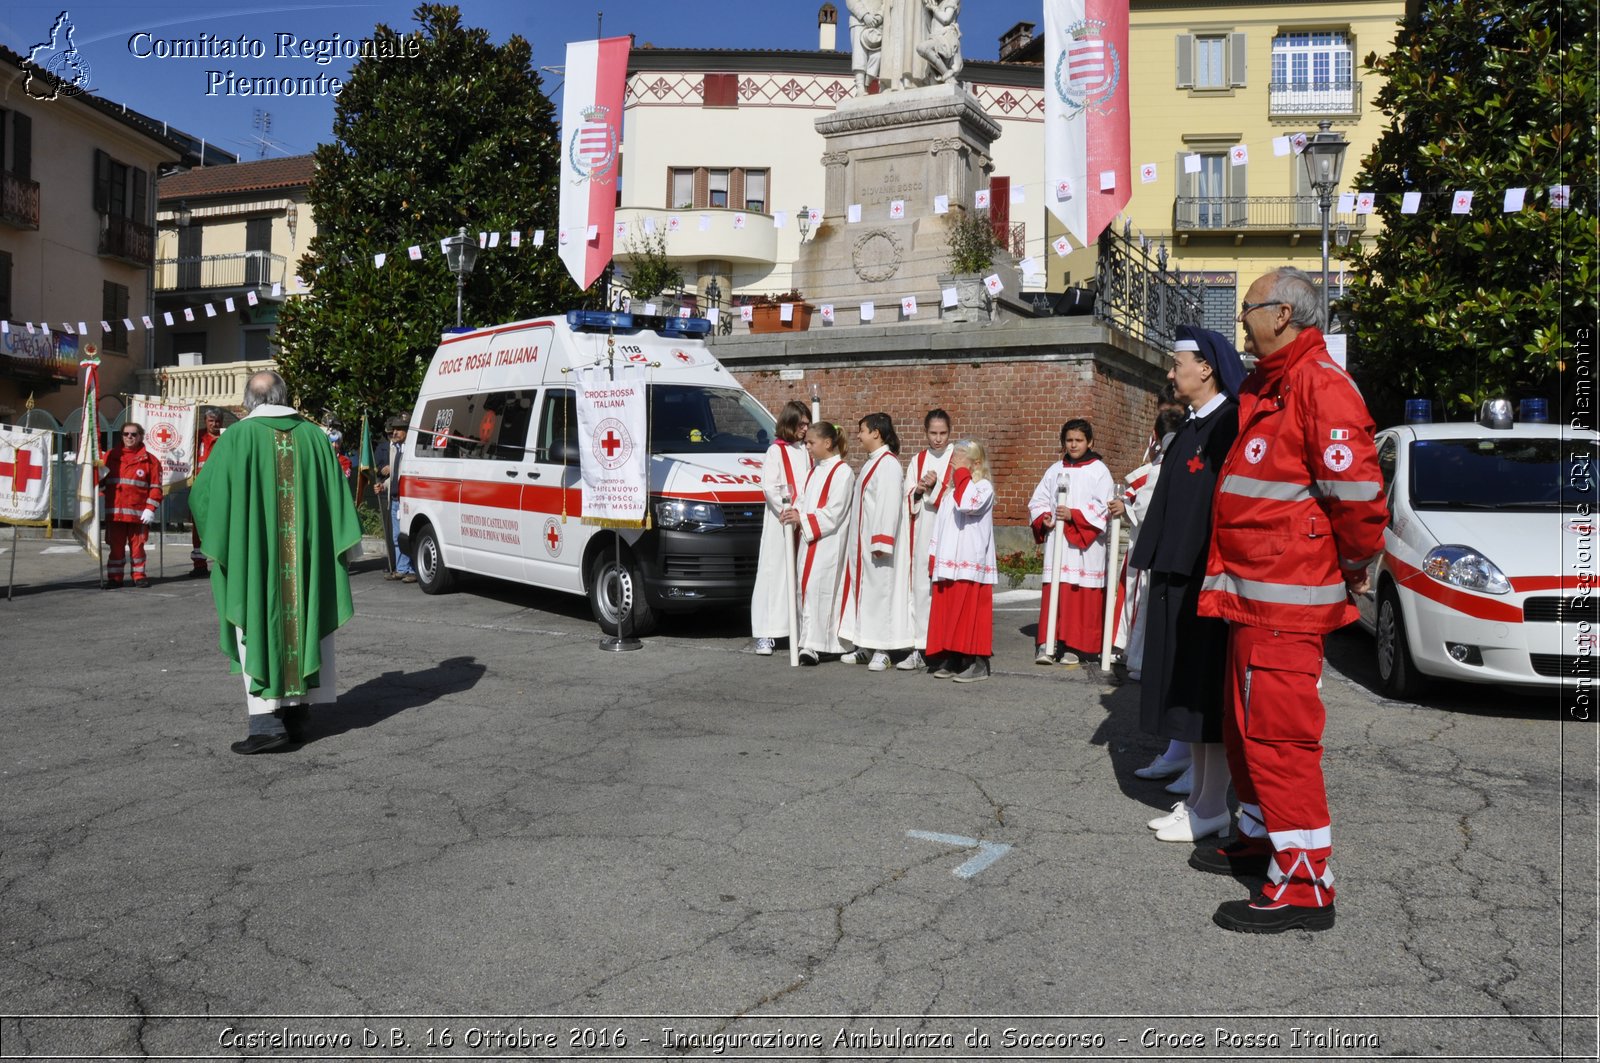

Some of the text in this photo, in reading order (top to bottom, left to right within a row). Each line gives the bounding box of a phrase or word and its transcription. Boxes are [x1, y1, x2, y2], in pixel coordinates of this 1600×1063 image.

[897, 182, 922, 192] BOSCO
[621, 345, 642, 354] 118
[439, 346, 538, 375] CROCE ROSSA ITALIANA
[585, 388, 634, 399] CROCE ROSSA
[594, 400, 625, 409] ITALIANA
